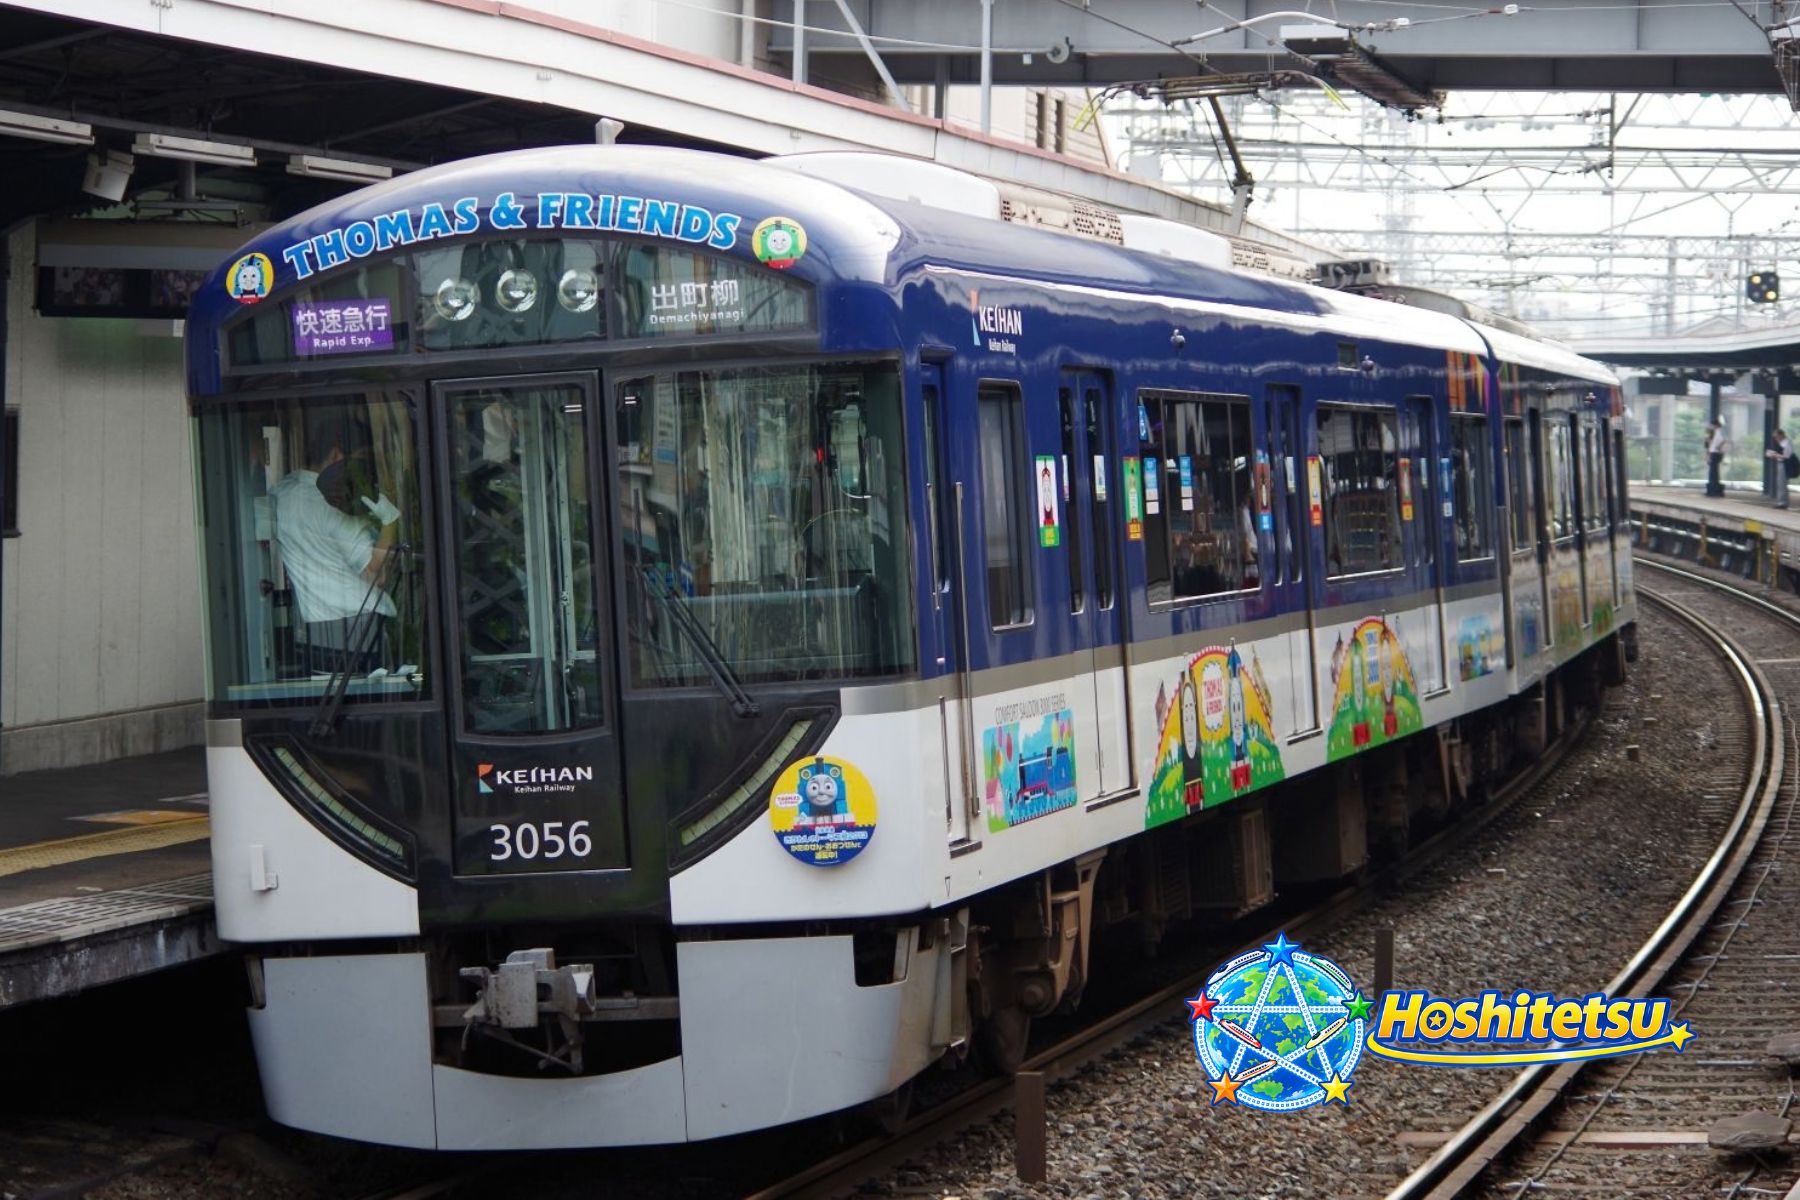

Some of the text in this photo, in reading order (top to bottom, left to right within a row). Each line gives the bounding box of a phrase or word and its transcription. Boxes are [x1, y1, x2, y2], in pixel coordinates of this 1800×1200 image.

[283, 192, 742, 280] THOMAS & FRIENDS
[651, 280, 739, 311] 出町柳
[295, 305, 388, 336] 快速急行
[650, 309, 744, 324] Demachiyanagi
[313, 335, 375, 350] Rapid Exp.
[514, 784, 575, 793] Keihan Railway
[490, 820, 592, 860] 3056
